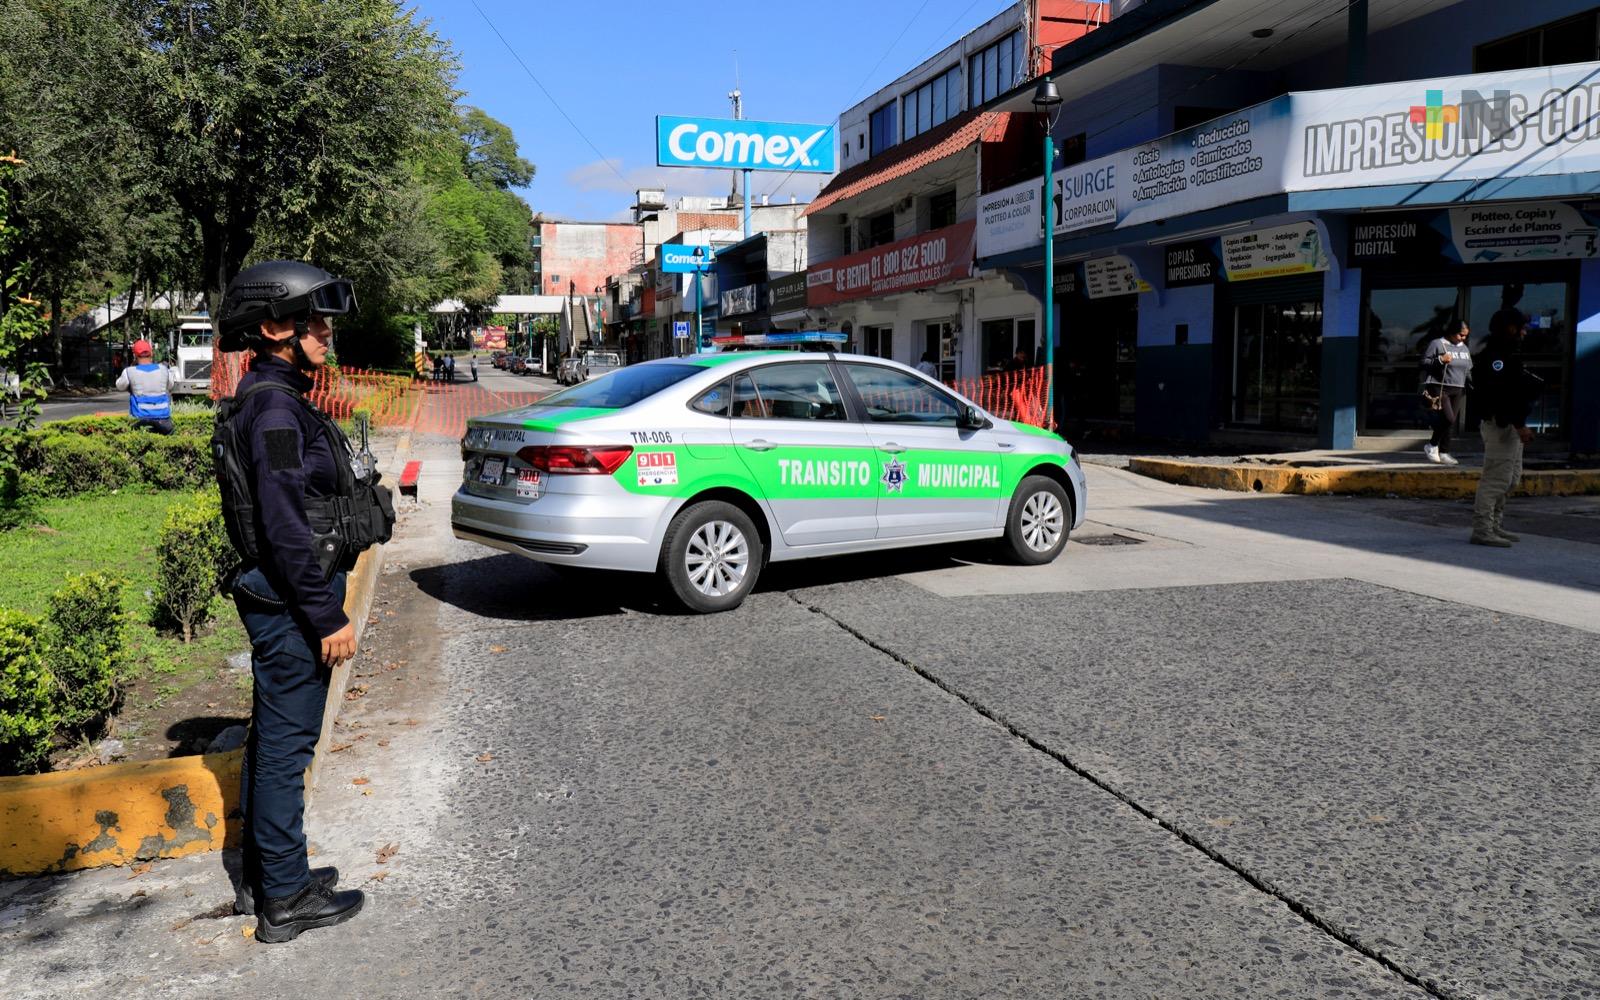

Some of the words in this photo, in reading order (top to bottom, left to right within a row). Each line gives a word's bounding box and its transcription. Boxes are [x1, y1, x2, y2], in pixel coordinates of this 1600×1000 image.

[1197, 120, 1249, 148] Reducción
[668, 122, 827, 168] Comex
[1196, 140, 1251, 167] Enmicados
[1138, 149, 1160, 166] Tesis
[1137, 158, 1185, 184] Antologías
[1196, 157, 1262, 186] Plastificados
[1065, 165, 1116, 201] SURGE
[1137, 177, 1187, 201] Ampliación
[1471, 211, 1513, 222] Plotteo,
[1515, 208, 1547, 220] Copia
[1549, 210, 1556, 219] y
[1355, 223, 1417, 239] IMPRESIÓN
[1464, 225, 1506, 236] Escáner
[1508, 223, 1522, 233] de
[1525, 222, 1562, 232] Planos
[1168, 249, 1195, 266] COPIAS
[1354, 240, 1397, 256] DIGITAL
[836, 269, 846, 292] SE
[846, 263, 870, 289] RENTA
[871, 256, 881, 279] 01
[883, 250, 900, 277] 800
[901, 245, 919, 272] 622
[921, 238, 946, 268] 5000
[1168, 262, 1211, 281] IMPRESIONES
[495, 429, 526, 443] MUNICIPAL
[630, 431, 673, 443] TM-006
[639, 454, 674, 466] 911
[778, 459, 870, 486] TRANSITO
[917, 463, 1000, 489] MUNICIPAL
